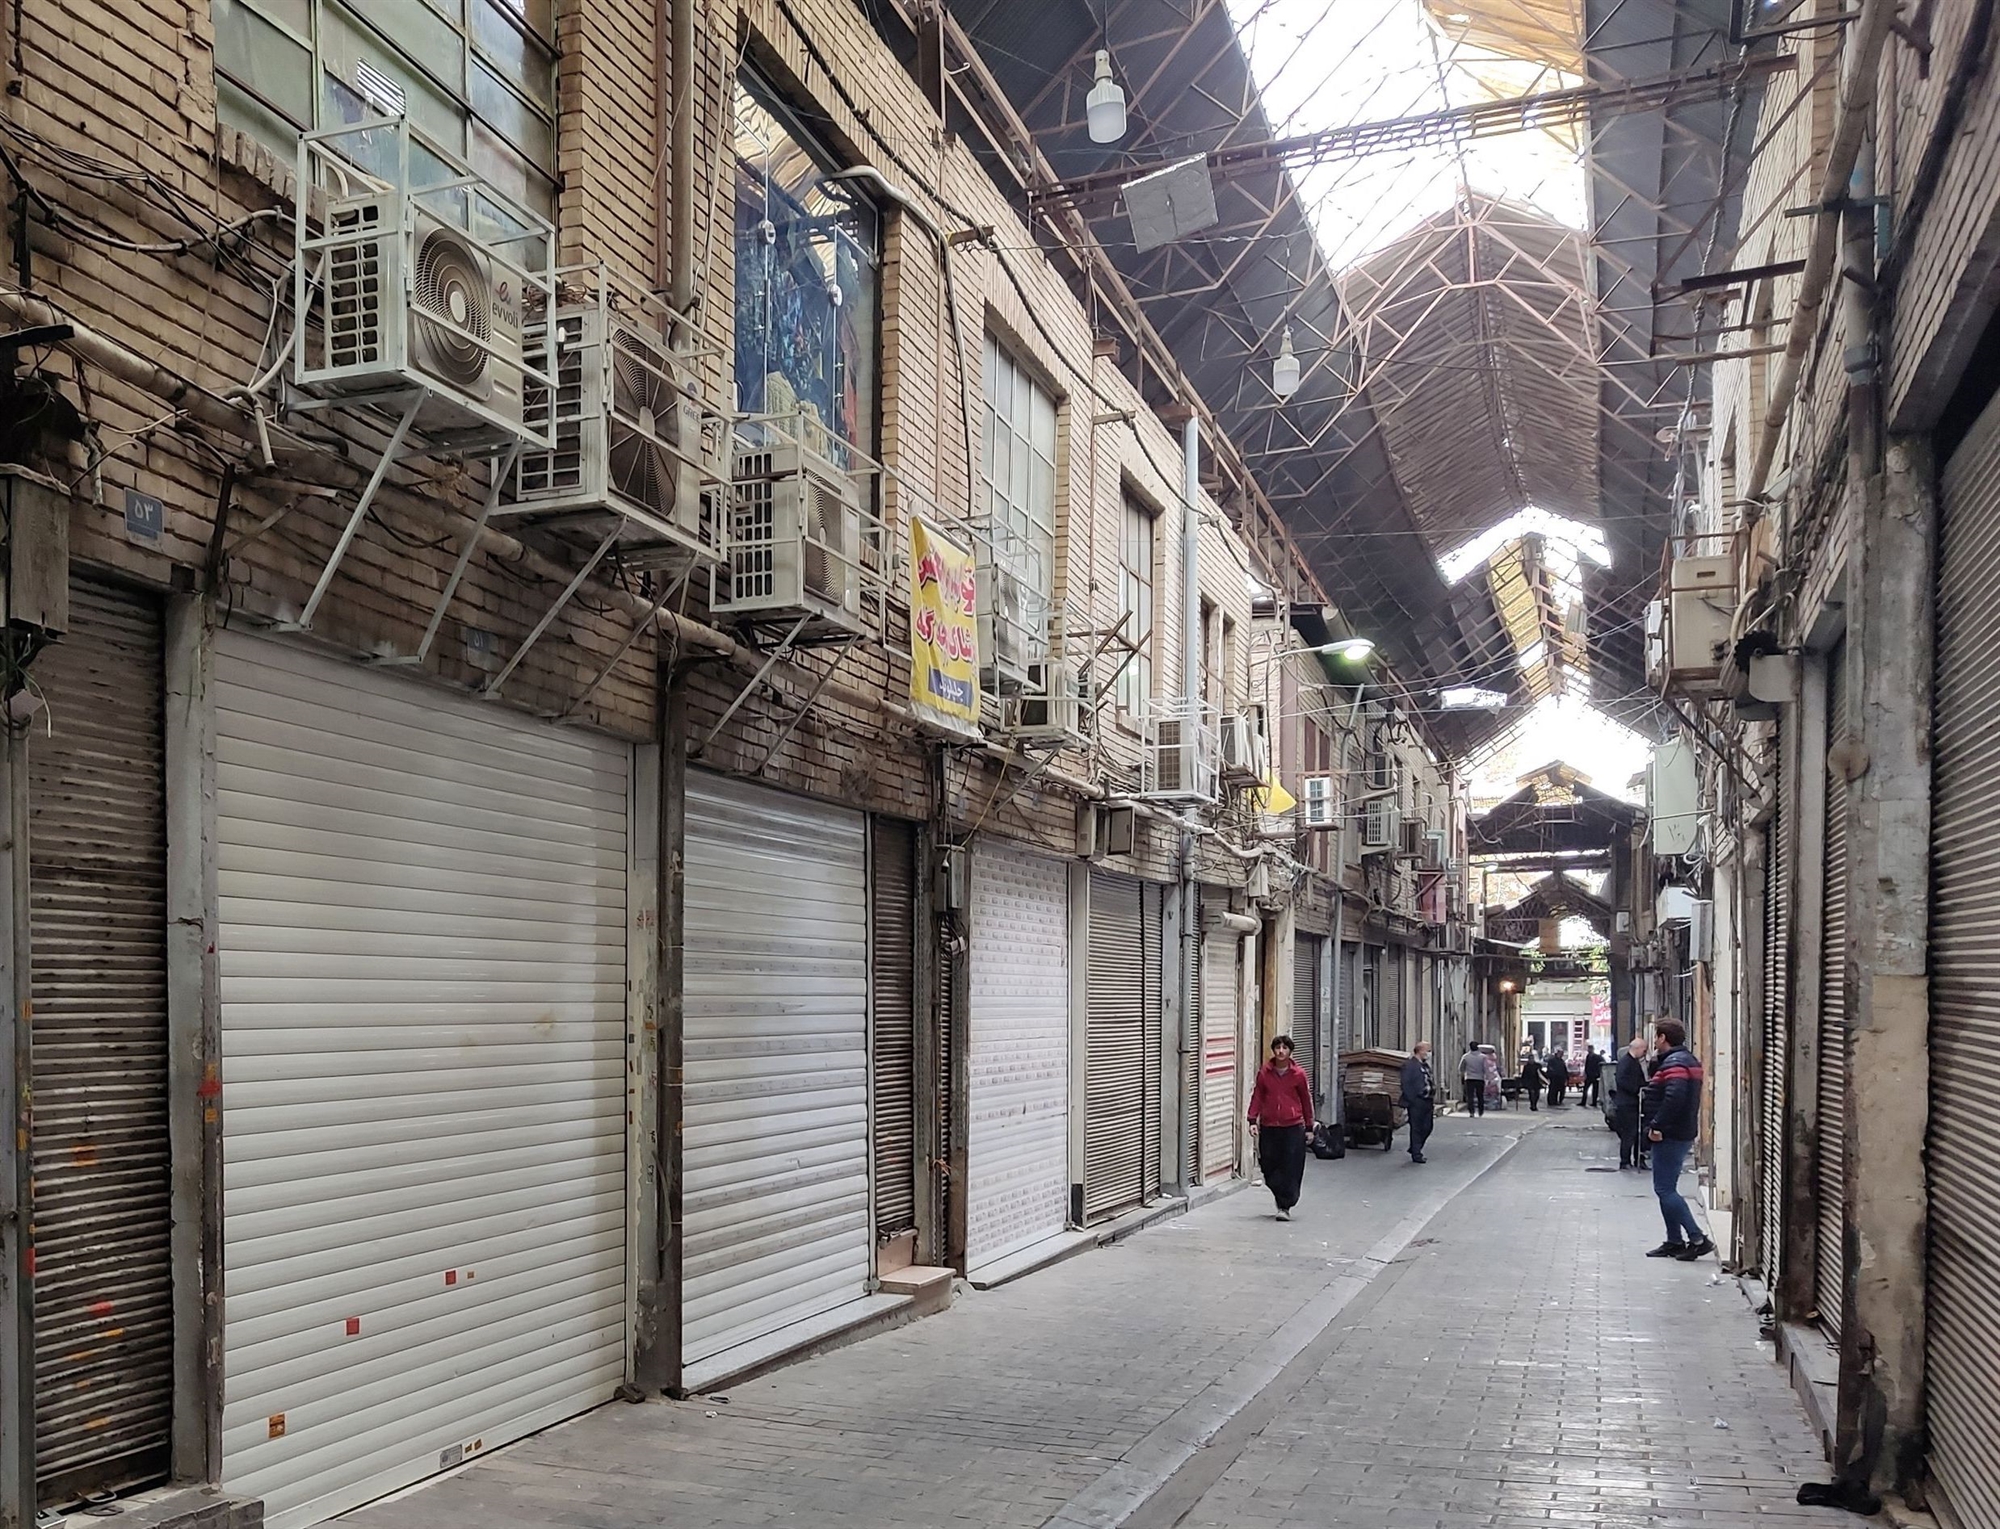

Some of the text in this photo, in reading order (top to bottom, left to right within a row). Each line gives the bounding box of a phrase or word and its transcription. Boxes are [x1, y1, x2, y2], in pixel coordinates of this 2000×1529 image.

[492, 302, 518, 329] evvoli
[683, 404, 701, 423] GREE
[134, 499, 154, 521] ۵۳
